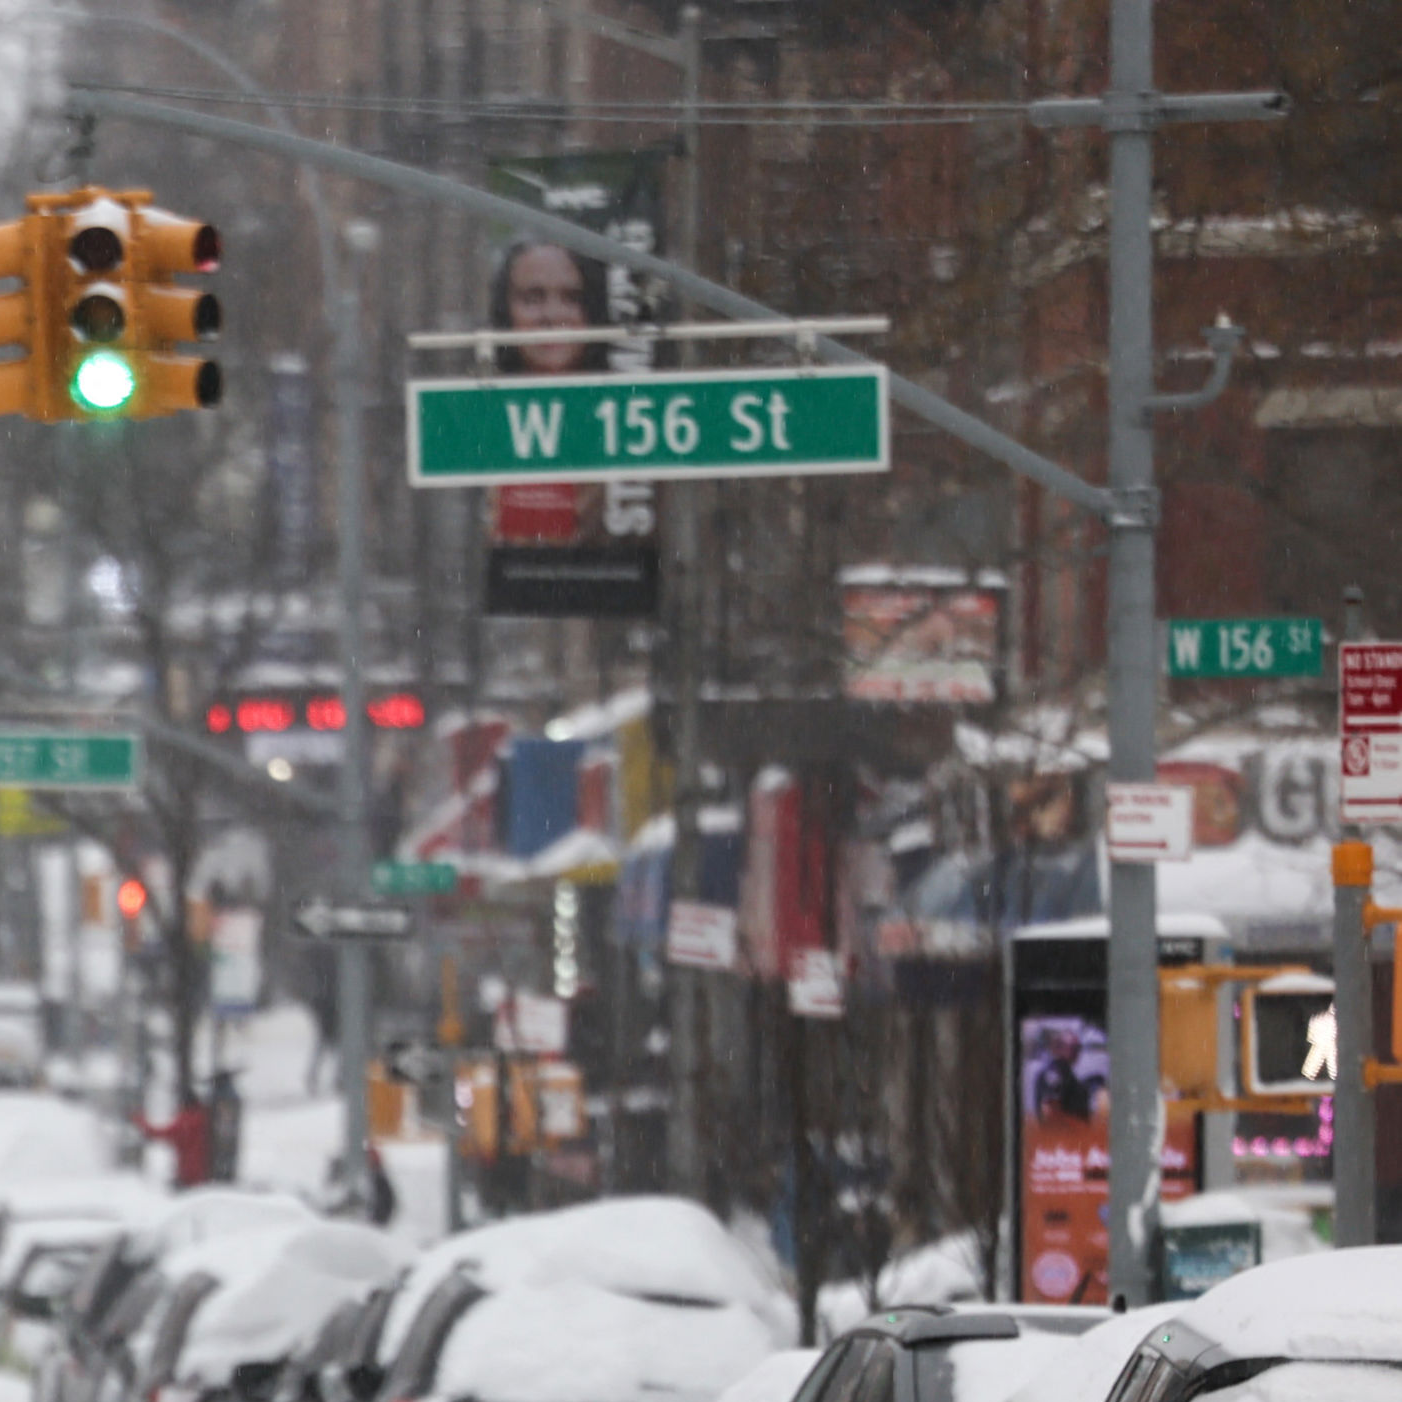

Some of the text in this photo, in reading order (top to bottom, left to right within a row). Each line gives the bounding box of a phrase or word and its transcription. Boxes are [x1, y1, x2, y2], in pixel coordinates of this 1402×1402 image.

[506, 390, 792, 459] W 156 St
[1173, 626, 1313, 671] W 156 St
